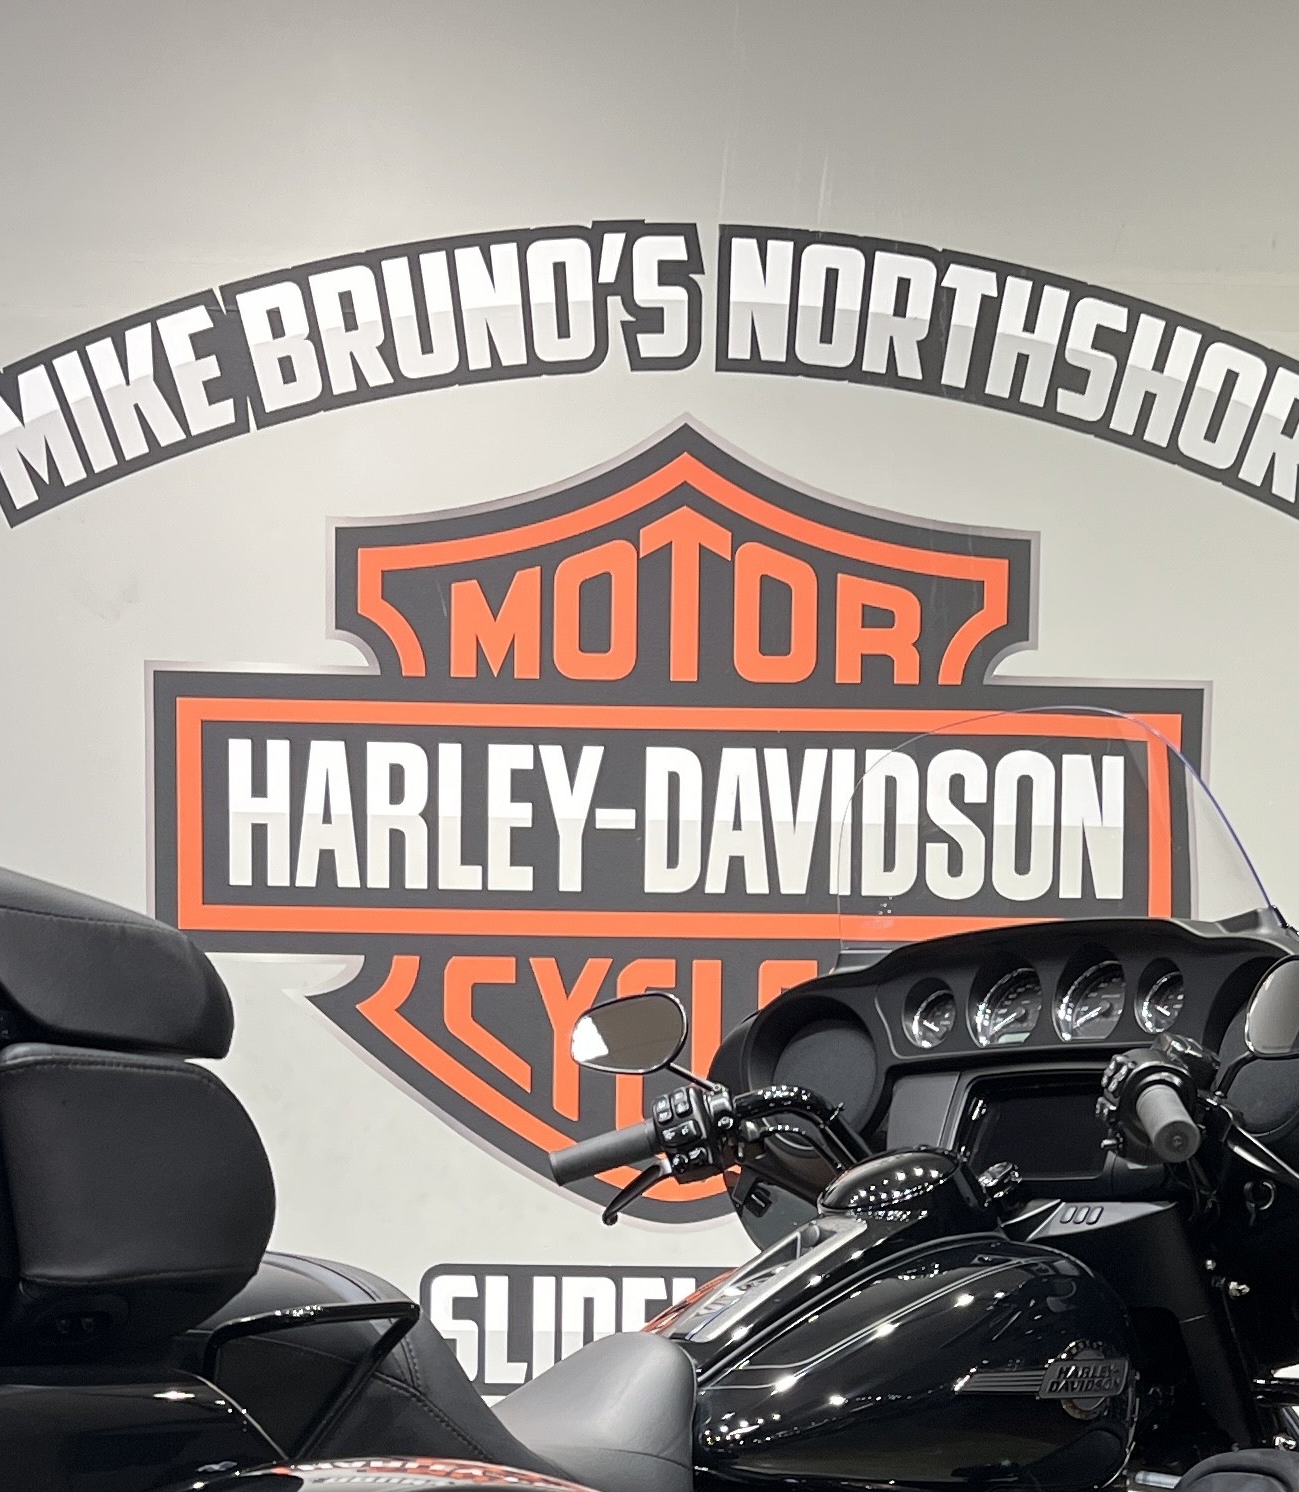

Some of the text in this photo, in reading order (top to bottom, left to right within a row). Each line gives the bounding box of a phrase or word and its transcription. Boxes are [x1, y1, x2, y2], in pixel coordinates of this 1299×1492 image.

[234, 231, 692, 412] BRUNO'S
[449, 503, 923, 686] MOTOR
[227, 737, 1125, 901] HARLEY-DAVIDSON
